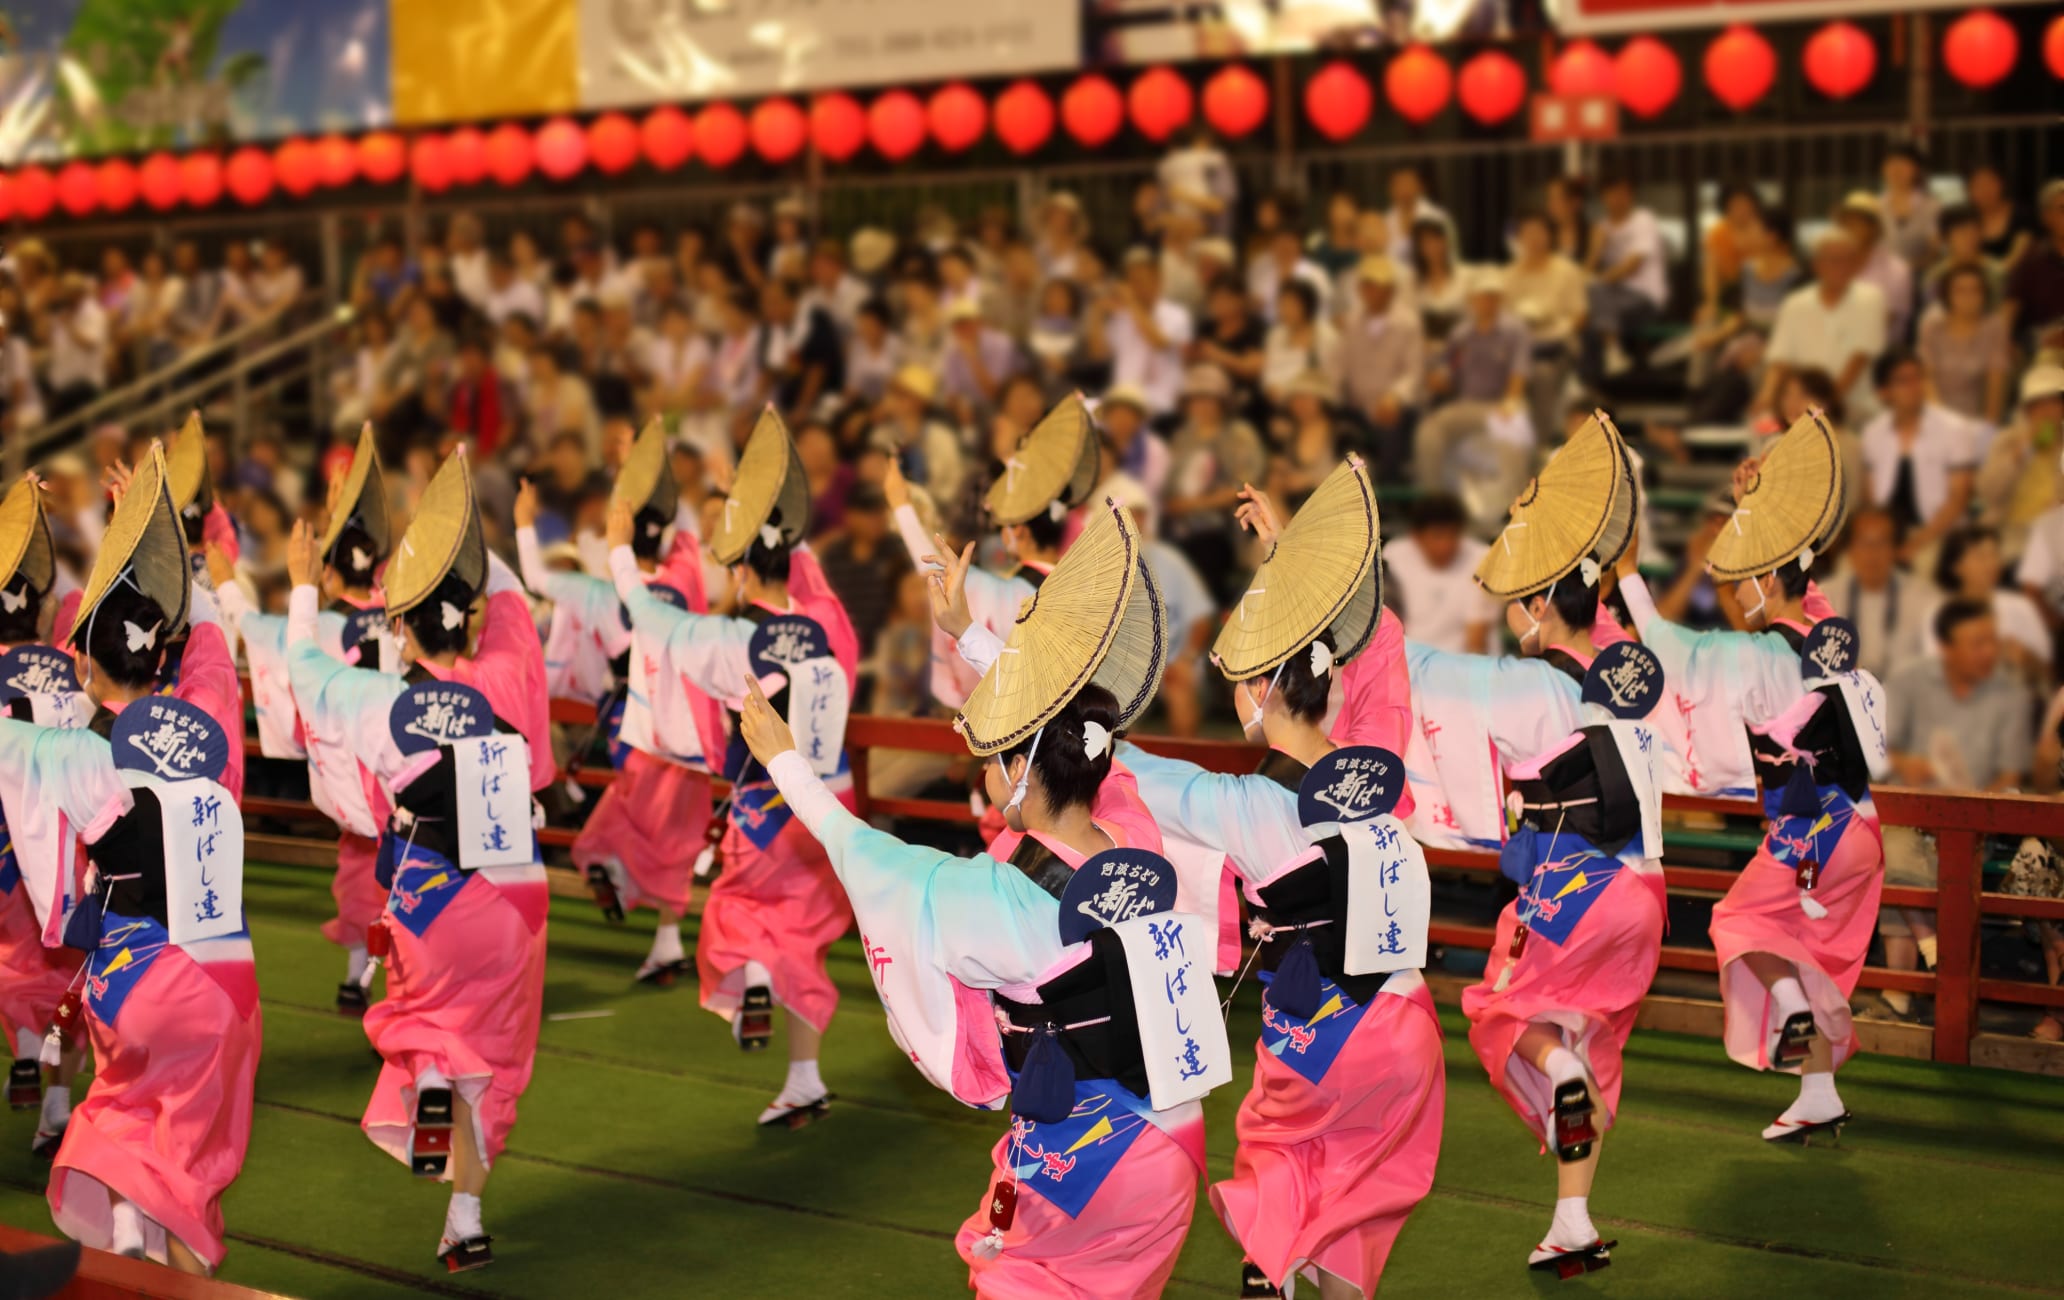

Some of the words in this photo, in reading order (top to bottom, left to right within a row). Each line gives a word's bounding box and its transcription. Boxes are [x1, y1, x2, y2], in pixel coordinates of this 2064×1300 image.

[478, 741, 512, 852] 新ばし連
[1334, 758, 1388, 776] 阿波おどり
[192, 795, 224, 922] 新ばし連
[1100, 862, 1161, 887] 阿波おどり
[1368, 824, 1407, 955] 新ばし連
[1148, 919, 1208, 1081] 新ばし連
